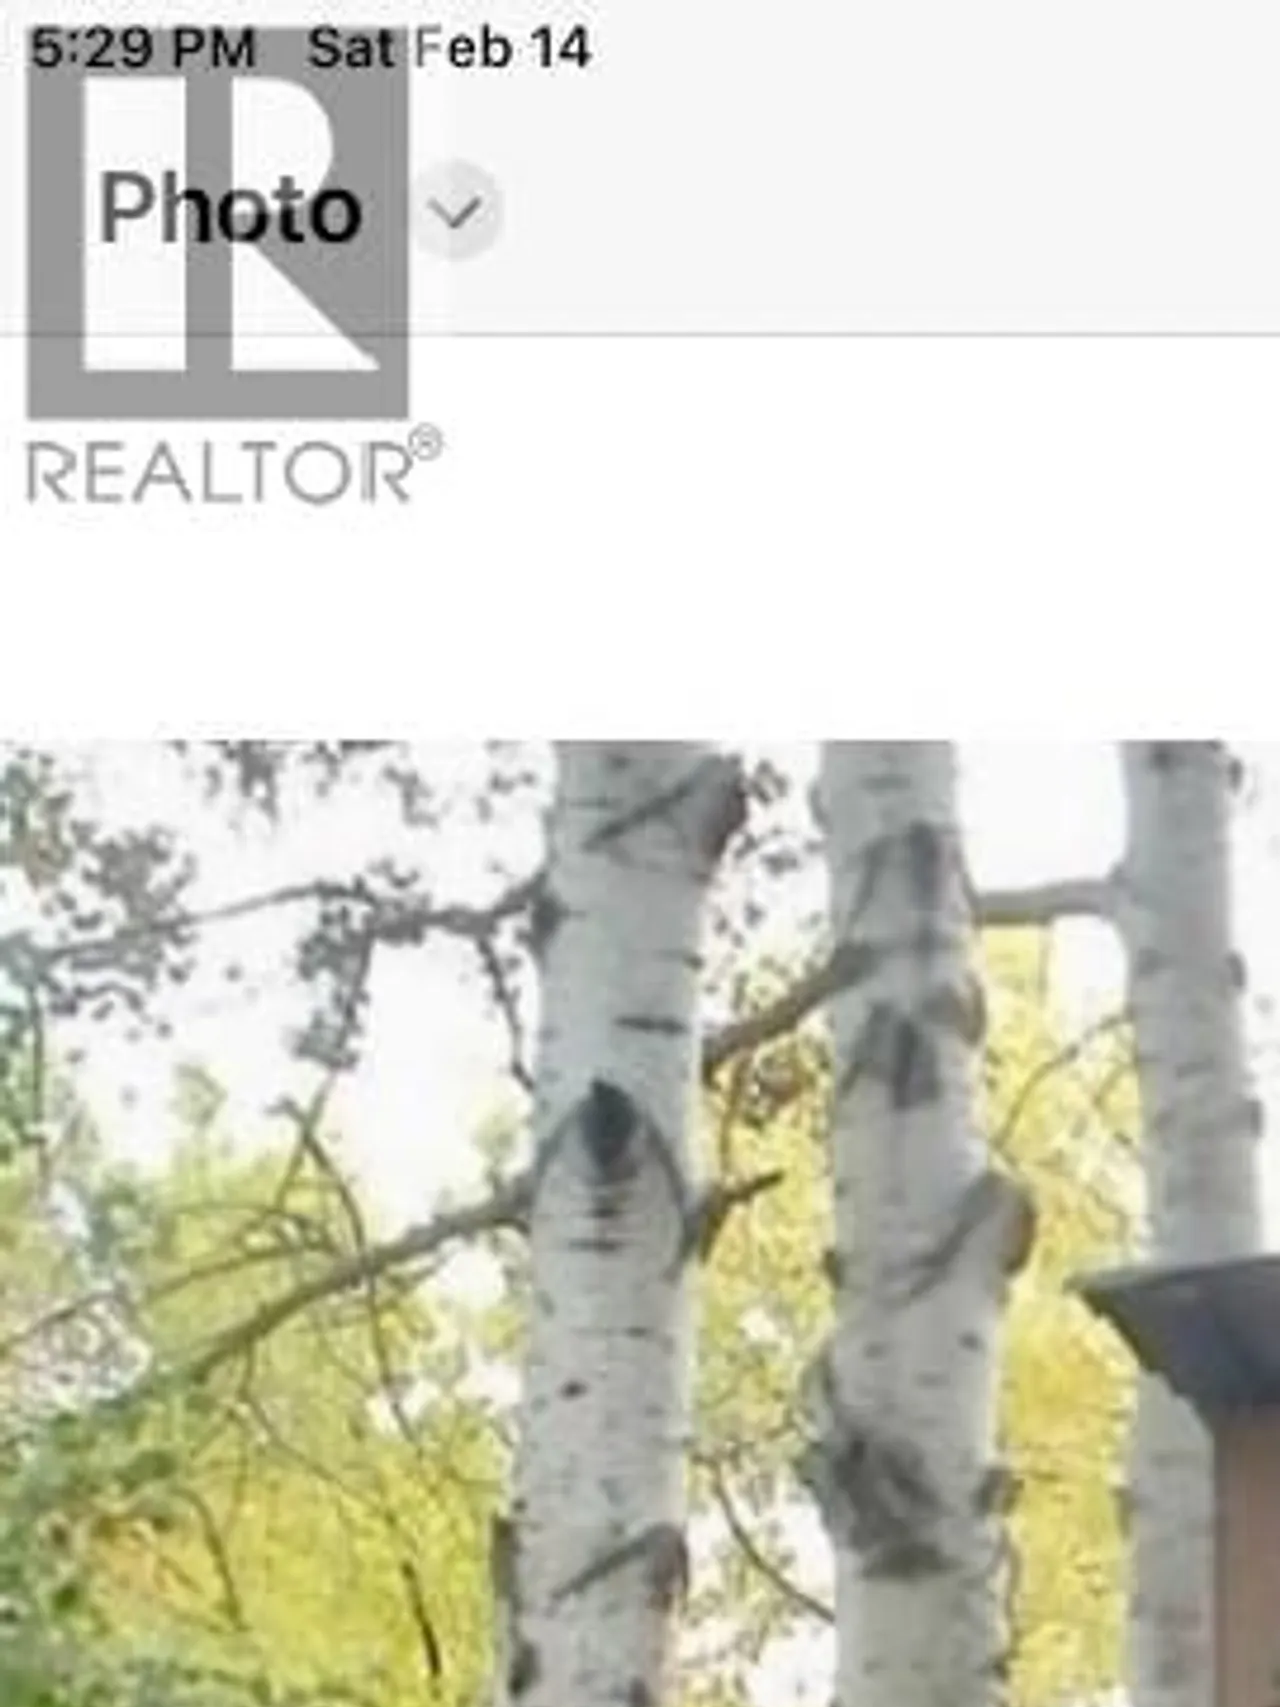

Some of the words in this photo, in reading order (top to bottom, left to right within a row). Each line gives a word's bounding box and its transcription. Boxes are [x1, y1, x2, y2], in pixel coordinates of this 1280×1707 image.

[30, 25, 153, 69] 5:29
[172, 26, 257, 69] PM
[308, 25, 396, 69] Sat
[416, 25, 514, 69] Feb
[530, 26, 592, 68] 14
[101, 169, 363, 244] Photo
